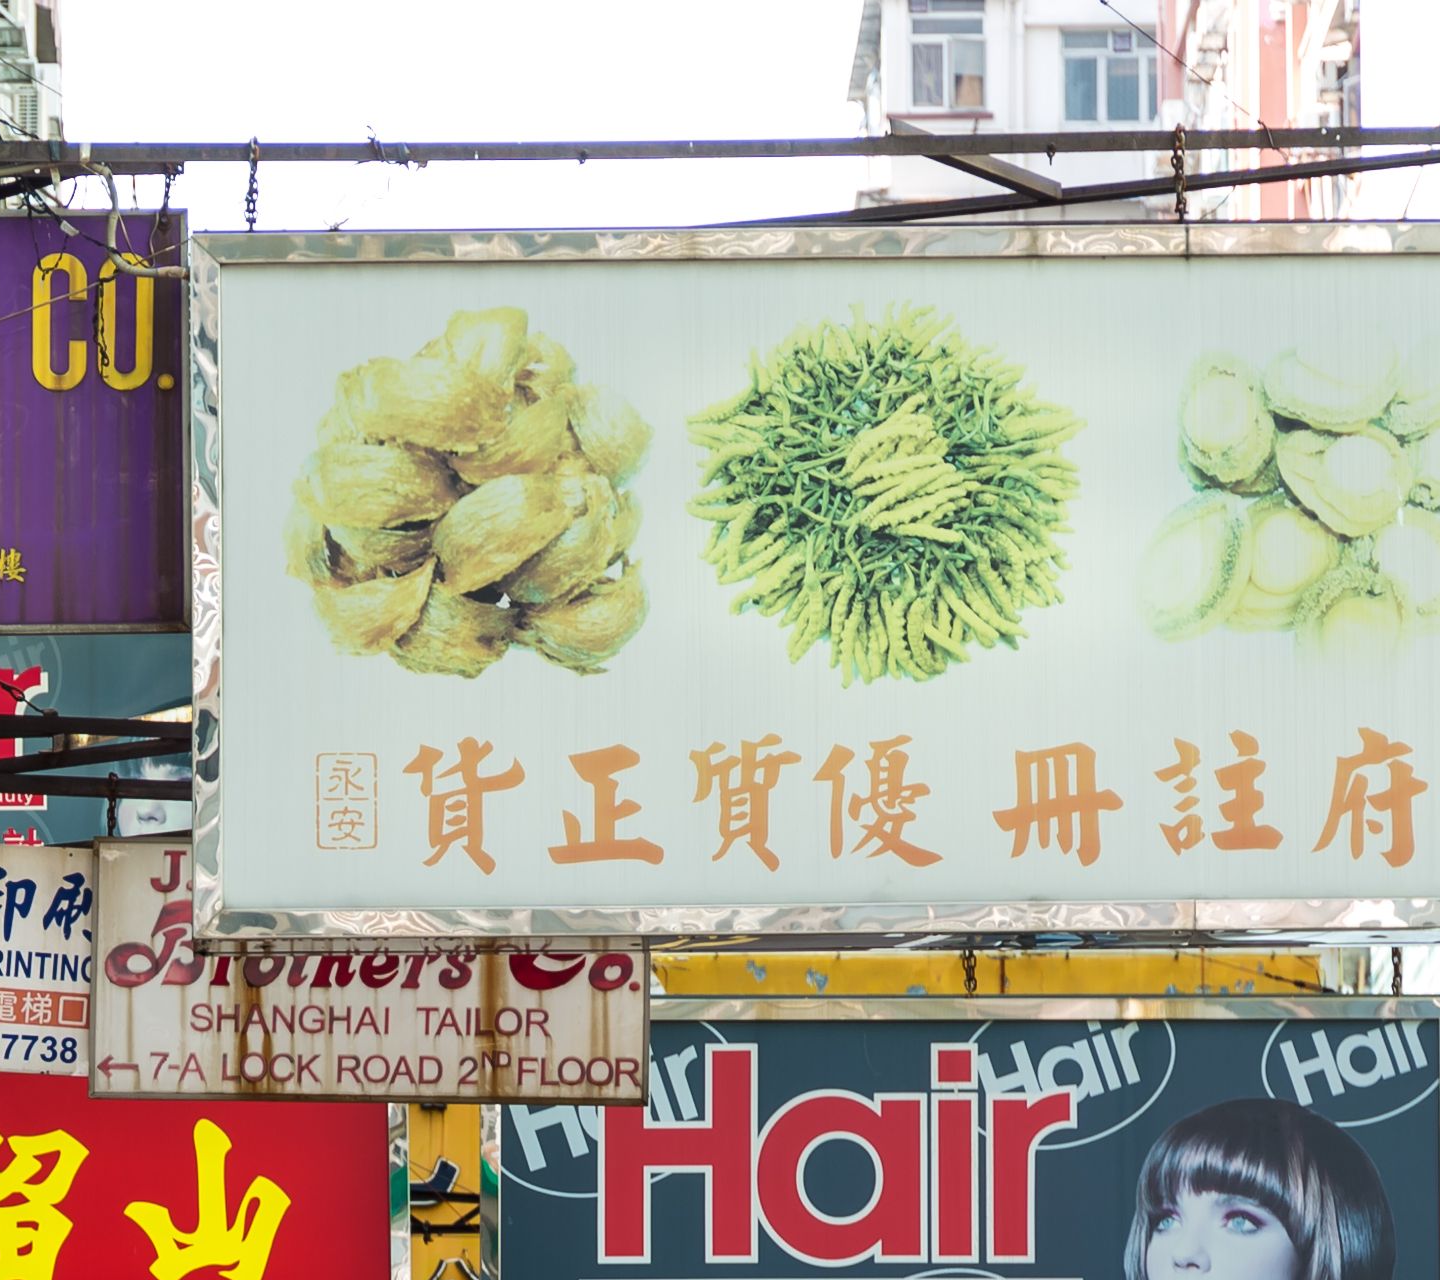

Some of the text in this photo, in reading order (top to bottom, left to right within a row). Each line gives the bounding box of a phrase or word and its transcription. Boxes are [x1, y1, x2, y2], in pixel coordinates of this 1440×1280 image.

[30, 249, 176, 393] CO.
[190, 1002, 552, 1038] SHANGHAI TAILOR
[222, 1053, 322, 1084] LOCK
[337, 1055, 444, 1085] ROAD
[518, 1057, 642, 1088] FLOOR
[596, 1042, 1076, 1264] Hair
